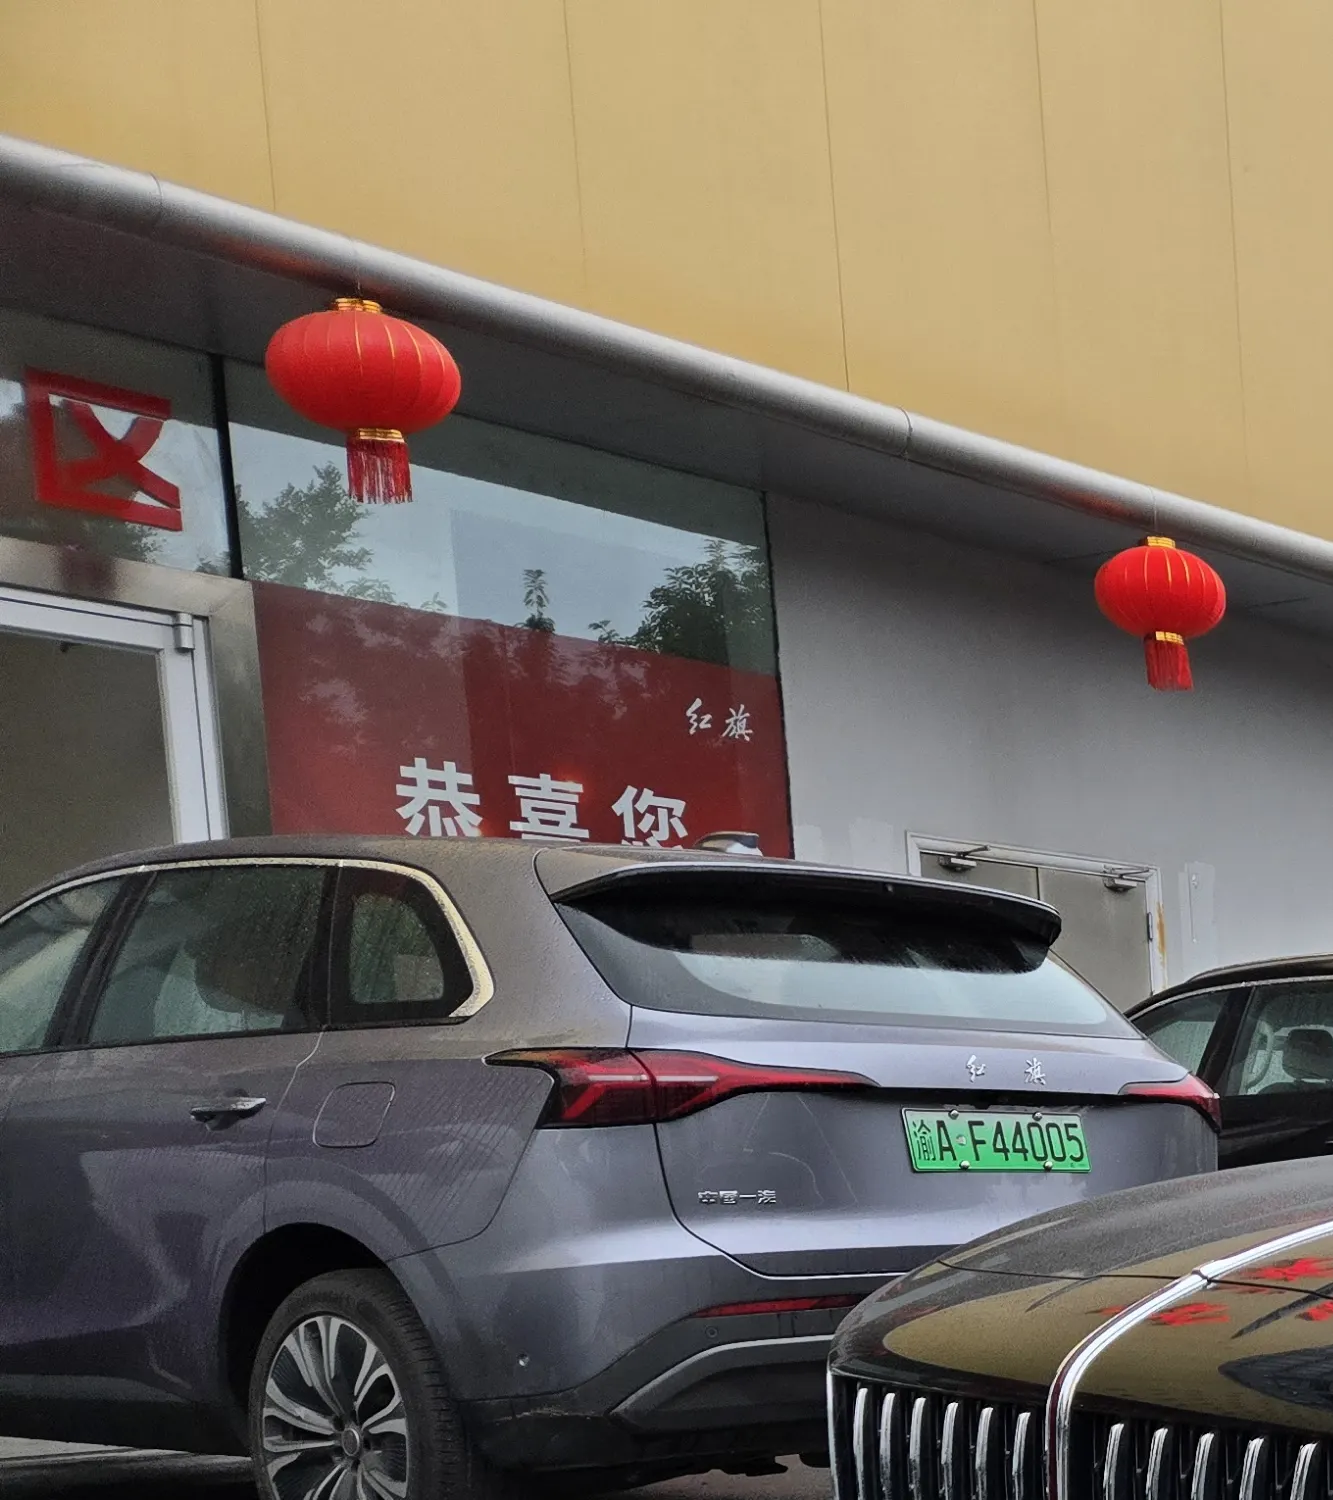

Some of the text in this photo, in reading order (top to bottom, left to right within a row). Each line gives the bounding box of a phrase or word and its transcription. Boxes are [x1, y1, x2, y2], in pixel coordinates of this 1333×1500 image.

[24, 364, 183, 531] 区
[685, 697, 754, 742] 红旗
[965, 1054, 1047, 1086] 红旗
